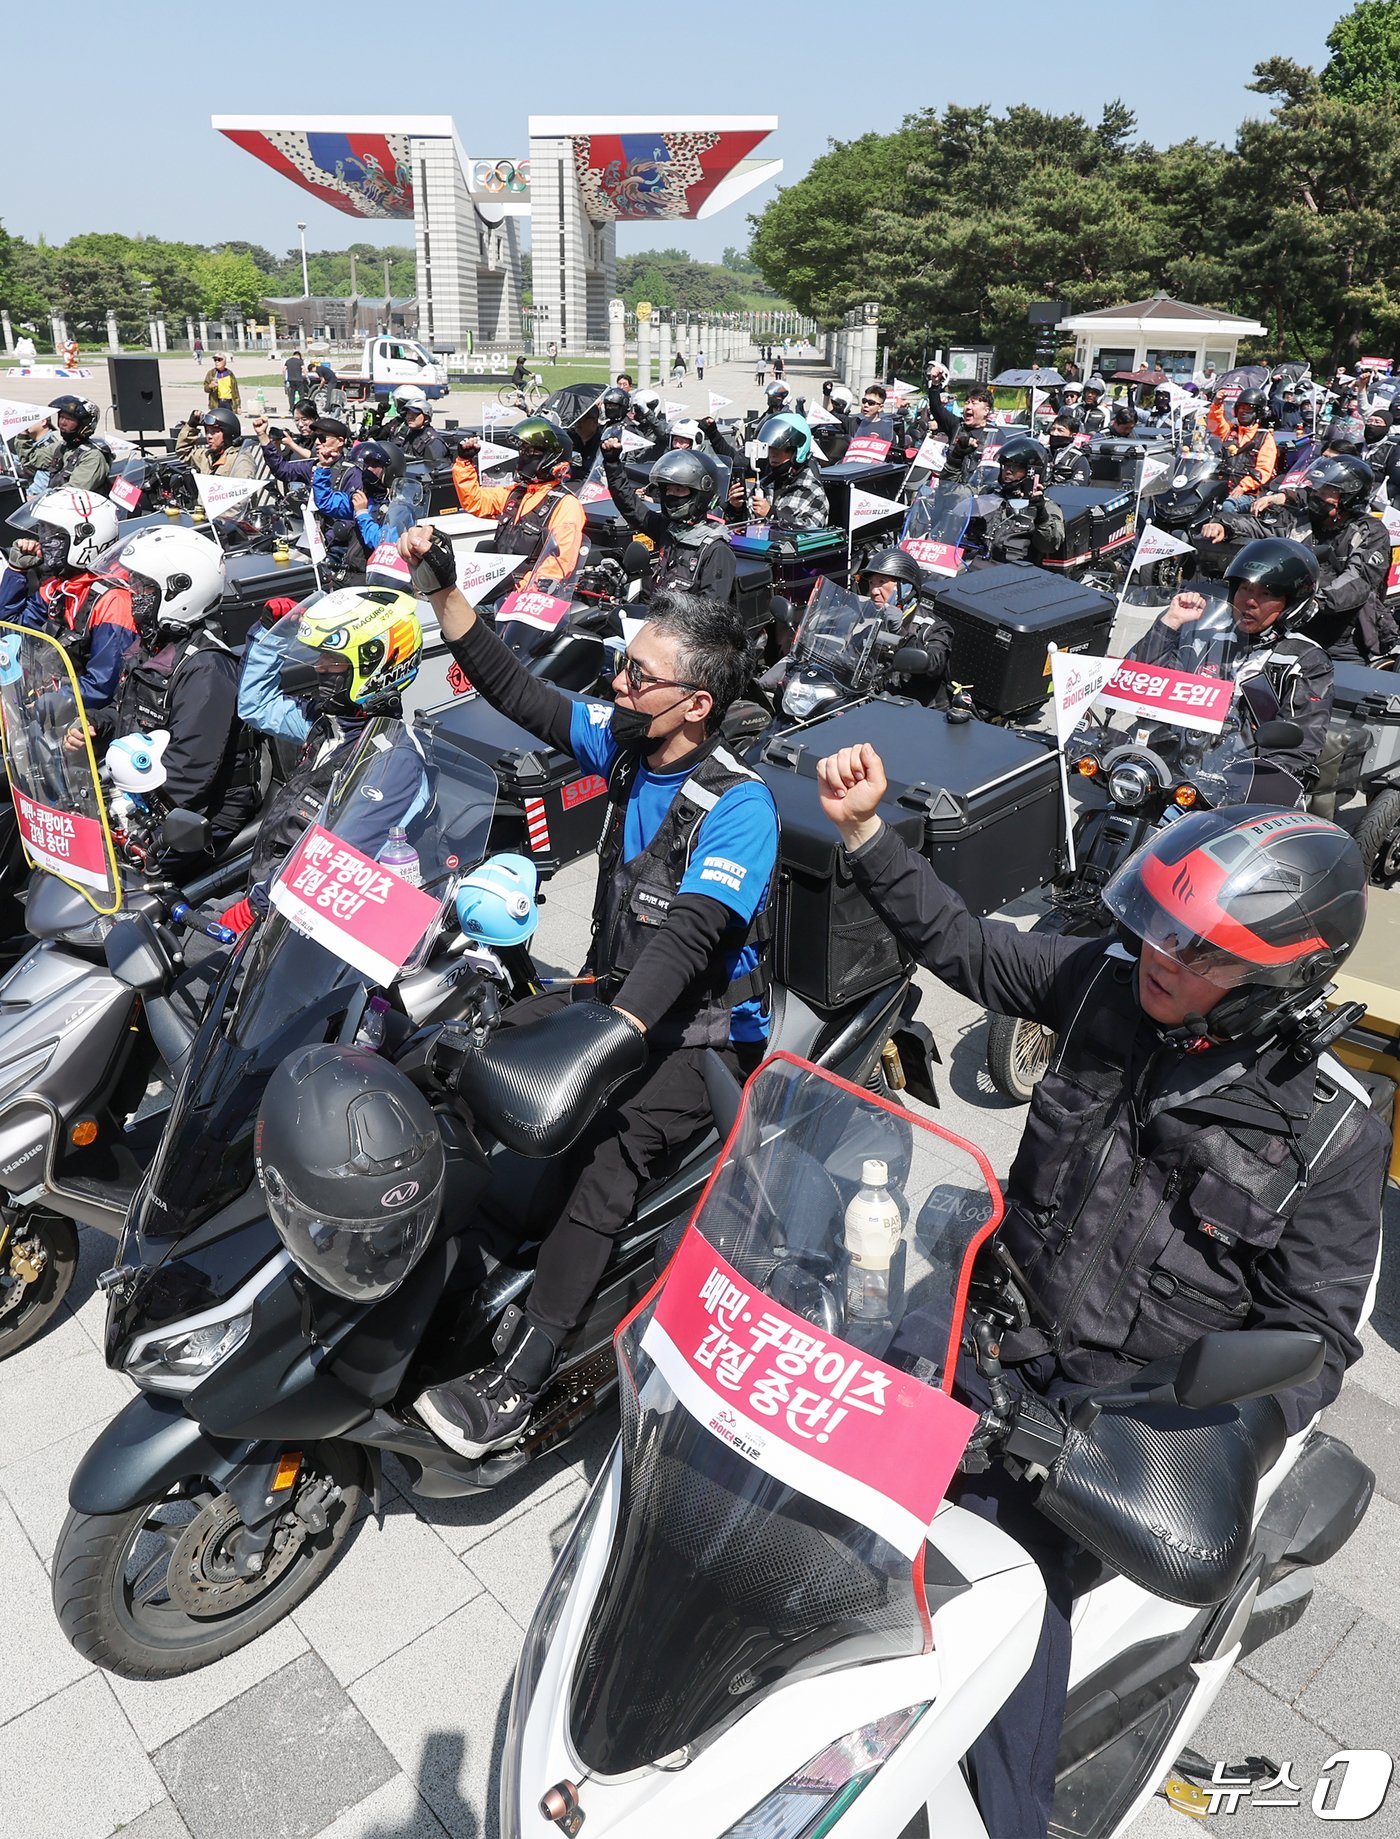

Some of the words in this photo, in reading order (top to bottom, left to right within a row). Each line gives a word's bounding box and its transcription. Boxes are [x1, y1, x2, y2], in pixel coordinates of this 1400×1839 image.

[463, 566, 507, 590] 라이더유니온
[352, 606, 385, 631] MAGURO
[1062, 675, 1104, 711] 라이더유니온
[1168, 682, 1221, 708] 도입!
[20, 797, 76, 838] 배민·쿠팡이츠
[1110, 815, 1133, 826] HONDA
[29, 822, 46, 848] 갑질
[47, 833, 70, 857] 중단!
[302, 832, 396, 905] 배민·쿠팡이츠
[700, 868, 741, 892] MOTUL
[291, 863, 323, 898] 갑질
[316, 879, 366, 921] 중단!
[65, 1007, 86, 1026] LED
[2, 1143, 44, 1175] Haojue
[697, 1266, 894, 1416] 배민·쿠팡이츠
[693, 1323, 756, 1391] 갑질
[748, 1367, 849, 1444] 중단!
[708, 1418, 761, 1461] 라이더유니온
